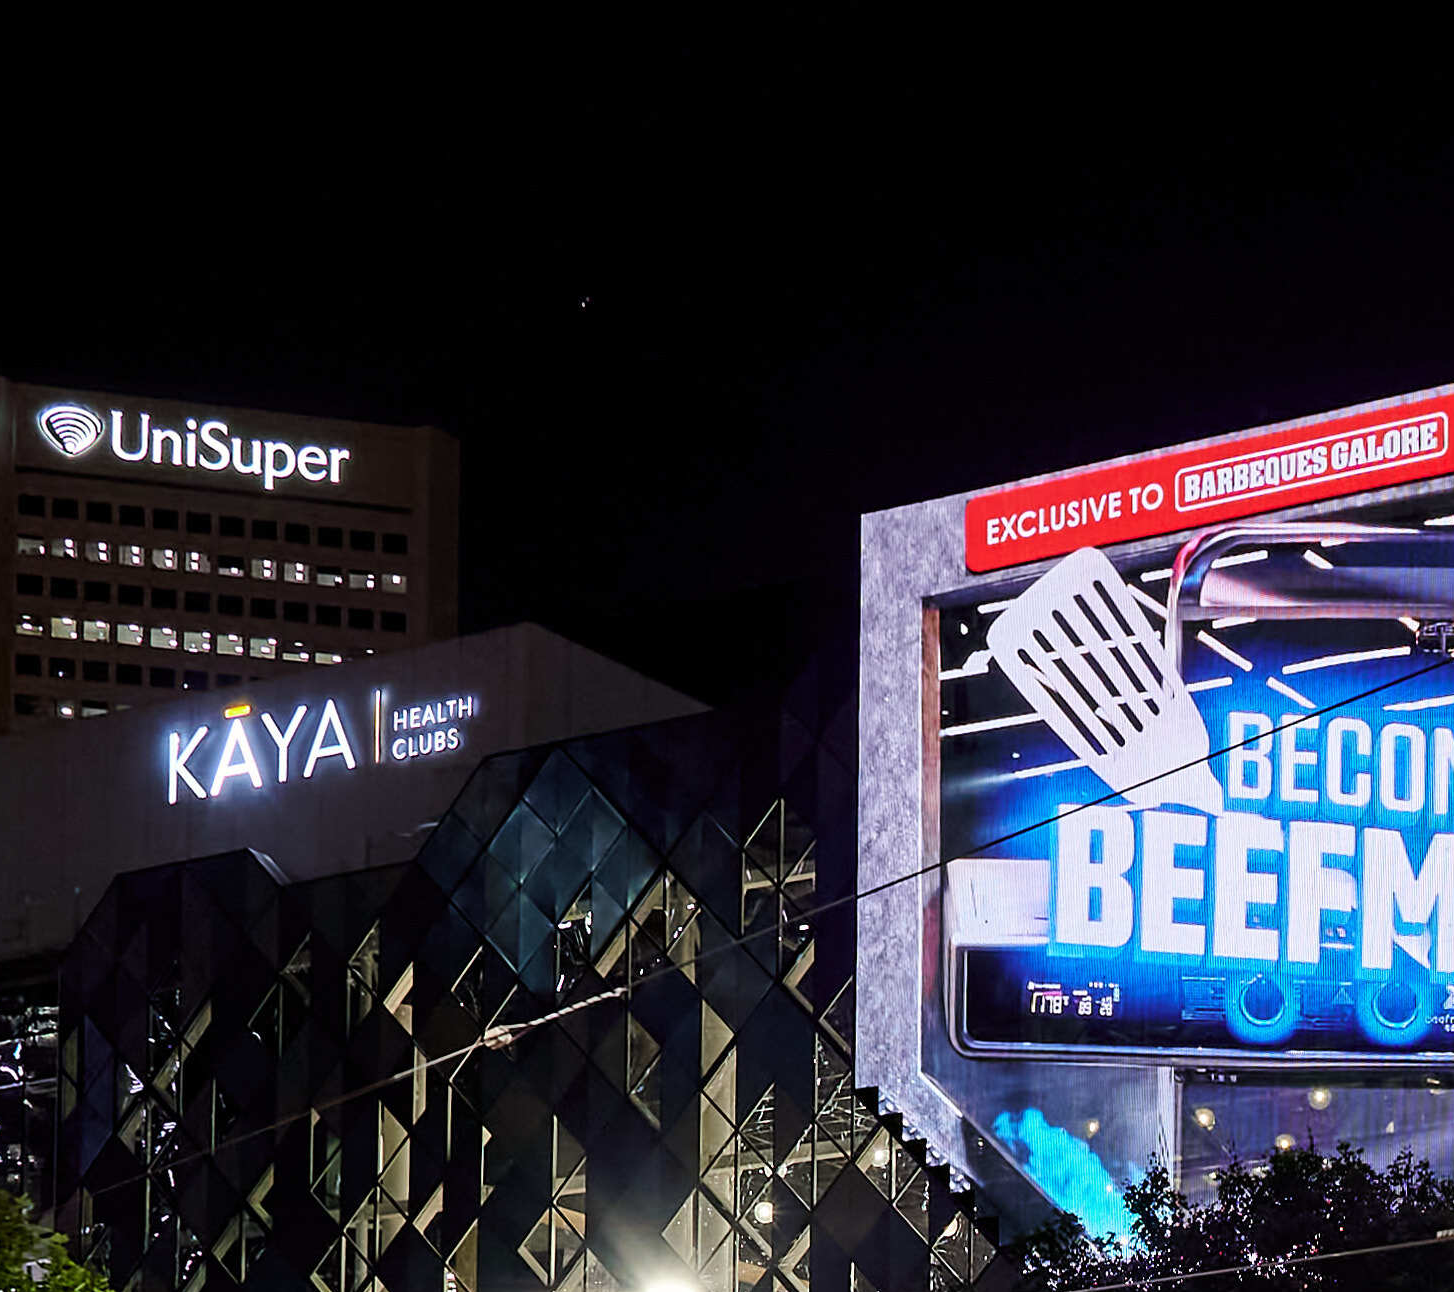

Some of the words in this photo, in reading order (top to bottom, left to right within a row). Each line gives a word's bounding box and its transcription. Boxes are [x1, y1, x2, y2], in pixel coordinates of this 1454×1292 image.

[109, 409, 350, 490] UniSuper
[986, 490, 1122, 546] EXCLUSIVE
[1129, 483, 1164, 515] TO
[1183, 446, 1329, 504] BARBEQUES
[1331, 420, 1438, 470] GALORE
[391, 726, 459, 760] CLUBS
[392, 695, 474, 732] HEALTH
